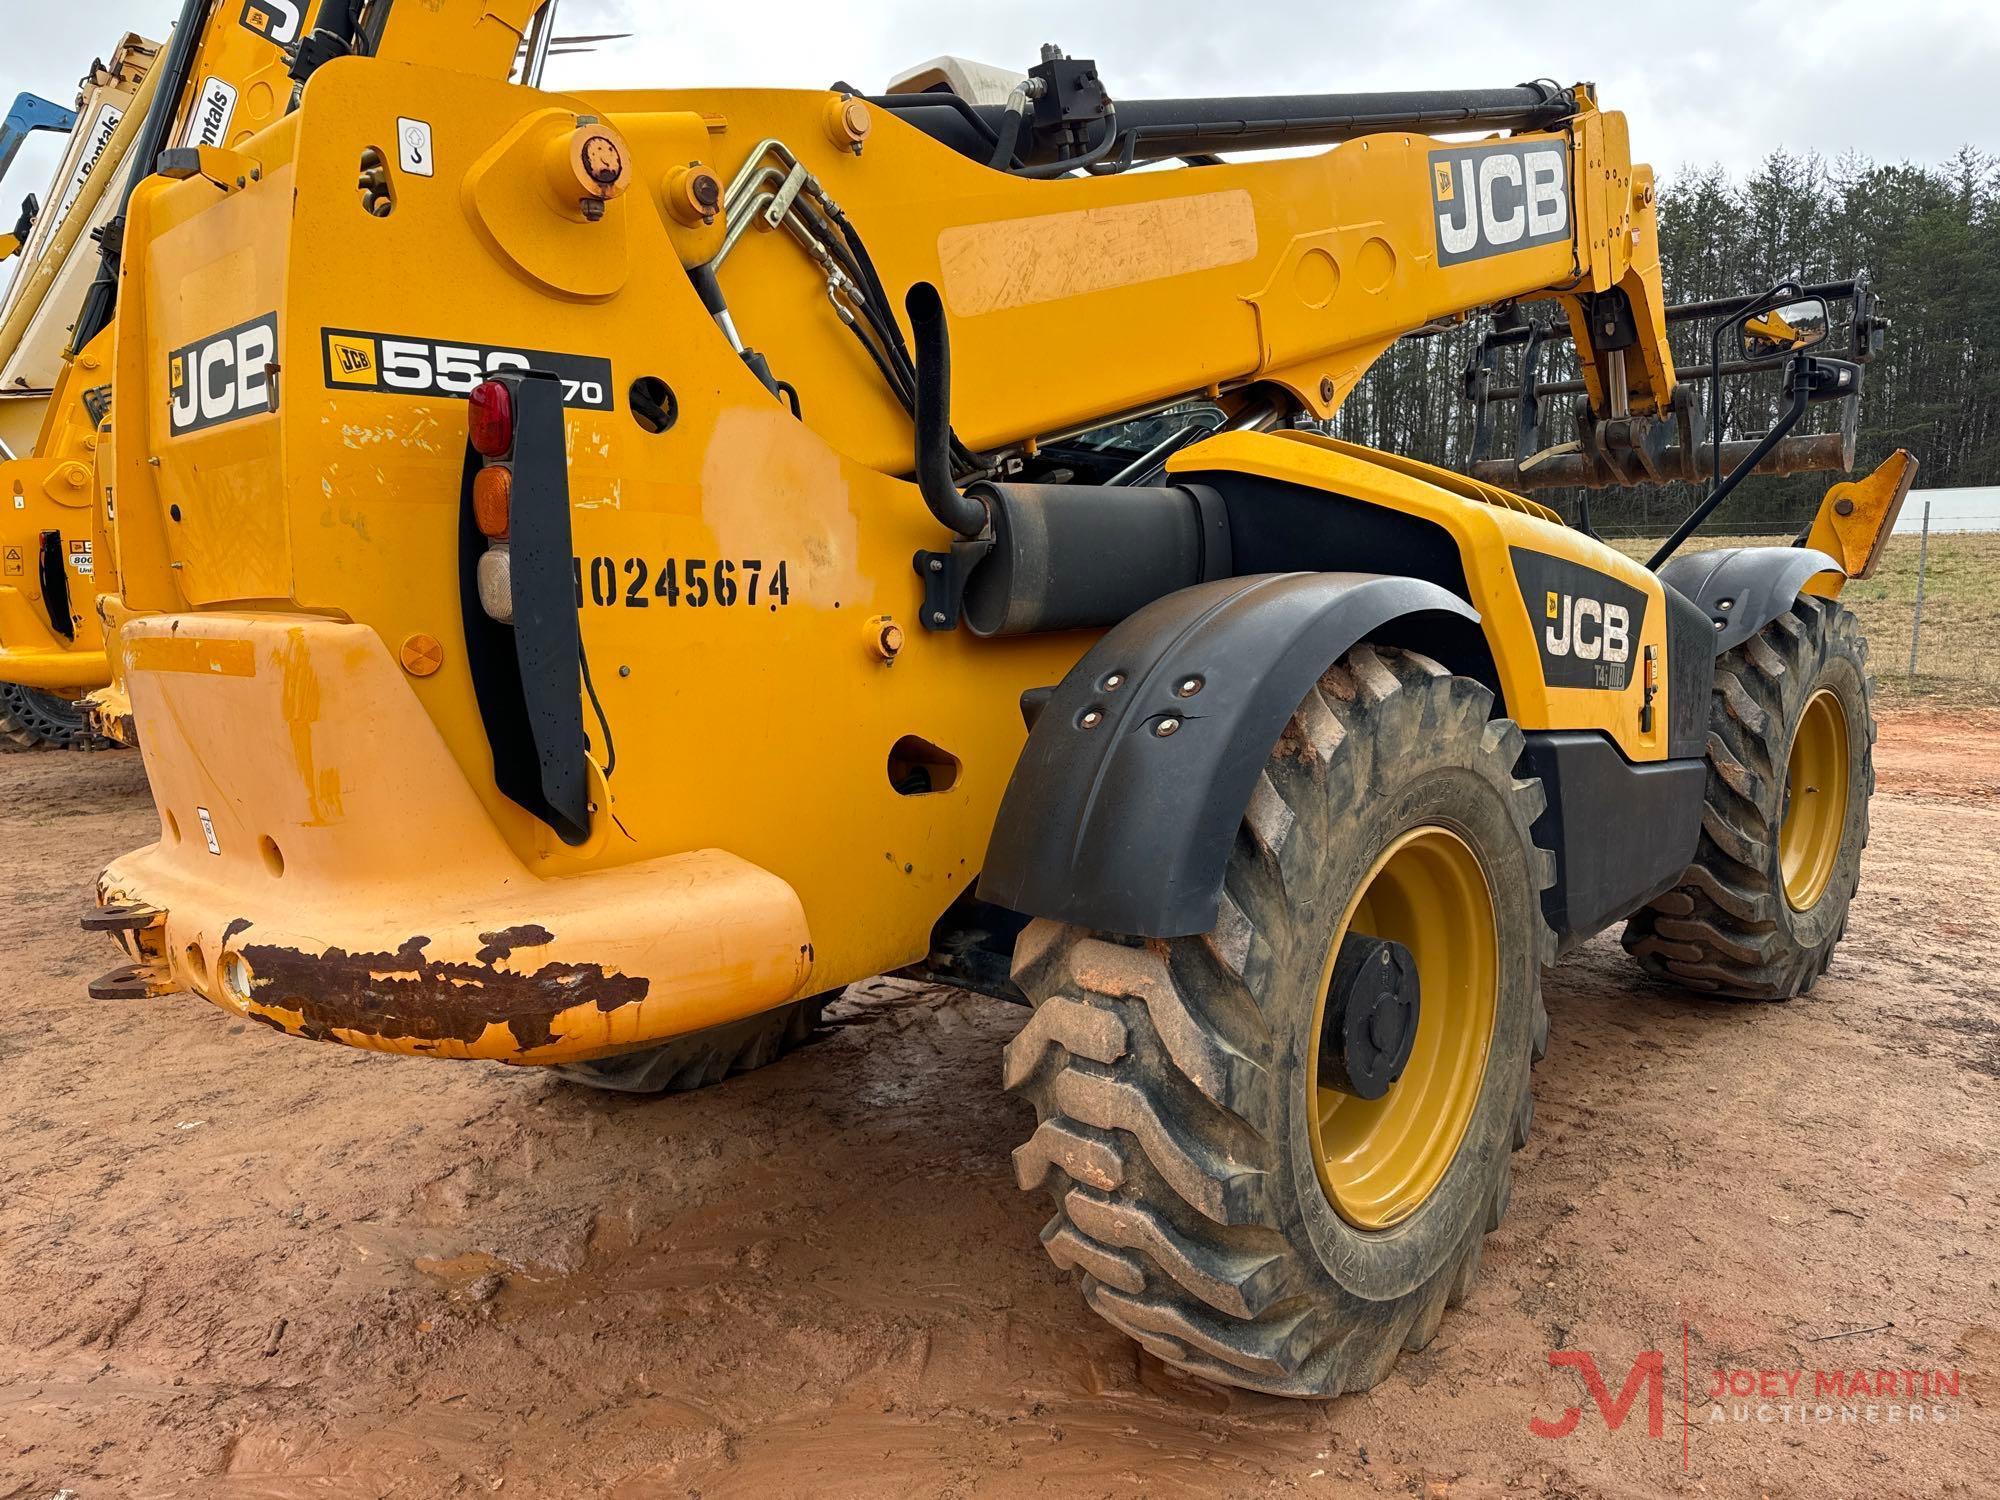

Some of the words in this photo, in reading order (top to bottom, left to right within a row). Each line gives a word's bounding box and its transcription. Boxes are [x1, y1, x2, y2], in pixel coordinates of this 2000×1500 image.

[1440, 151, 1567, 254] JCB
[172, 325, 274, 427] JCB
[341, 347, 369, 370] JCB
[1546, 595, 1630, 663] JCB
